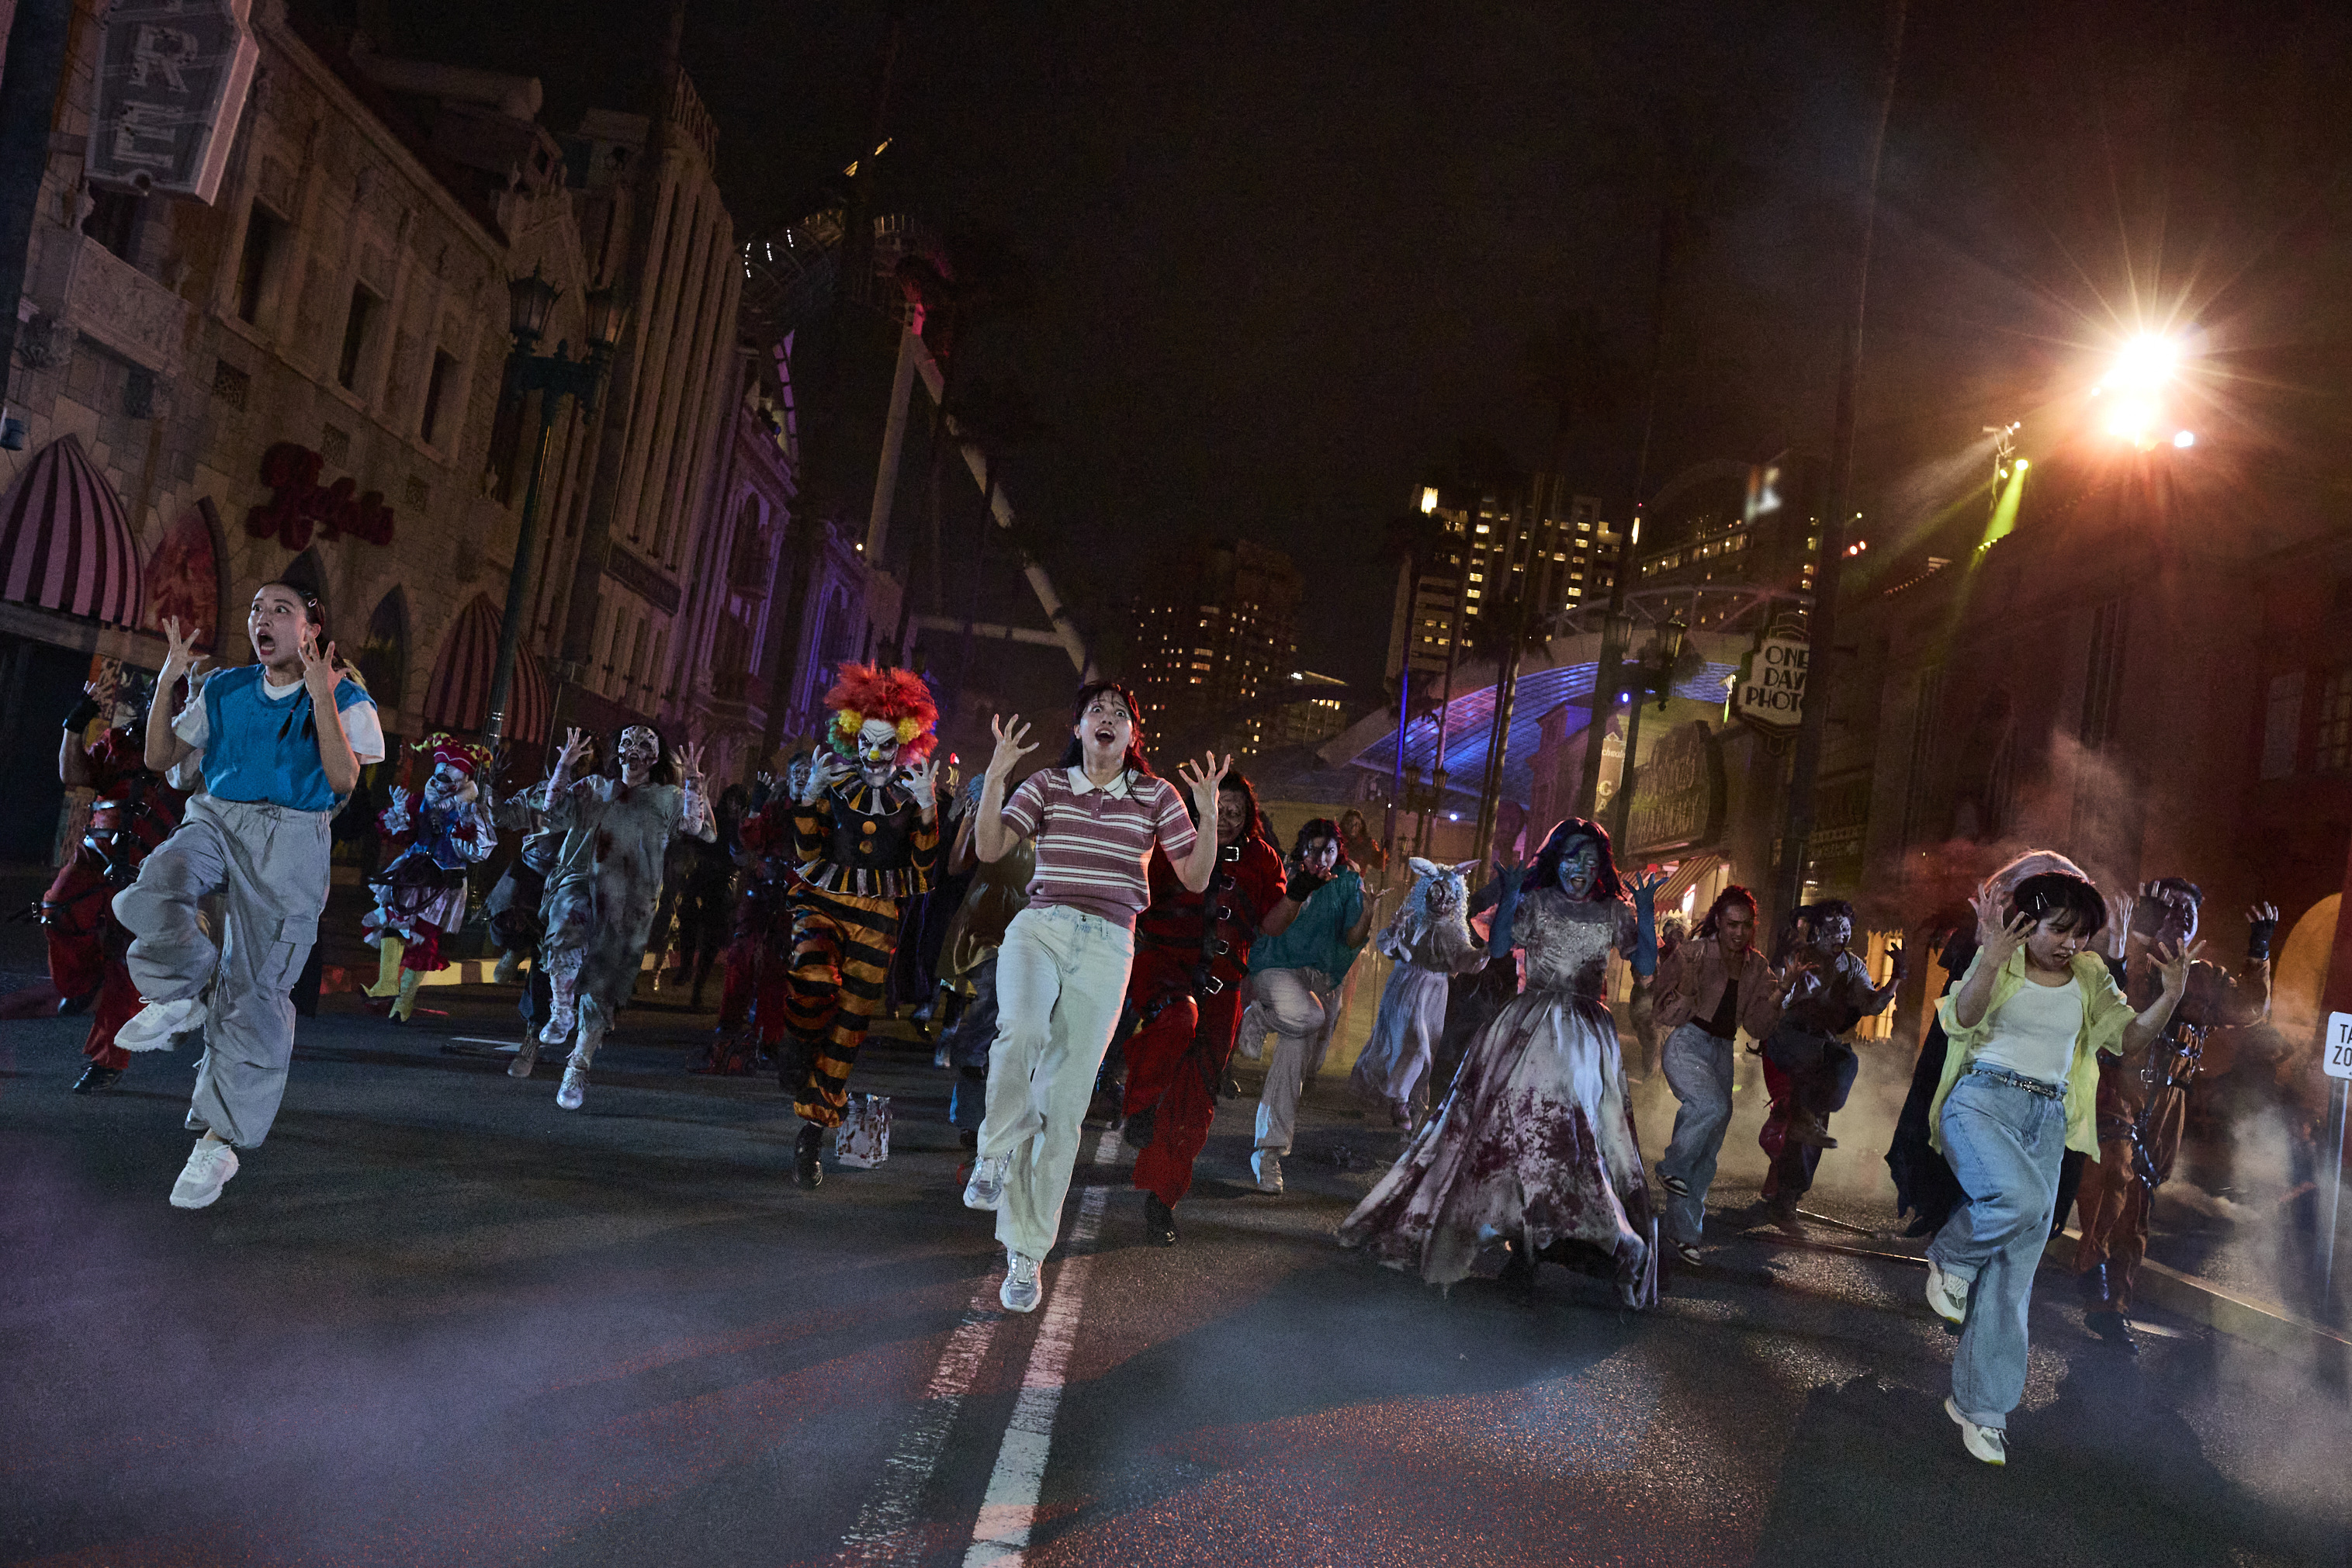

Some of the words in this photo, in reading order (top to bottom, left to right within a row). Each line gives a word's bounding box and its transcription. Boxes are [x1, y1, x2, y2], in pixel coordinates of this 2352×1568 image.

[113, 0, 199, 168] RE
[1765, 646, 1809, 669] ONE
[1765, 667, 1806, 690] DAY
[1745, 687, 1802, 711] PHOT
